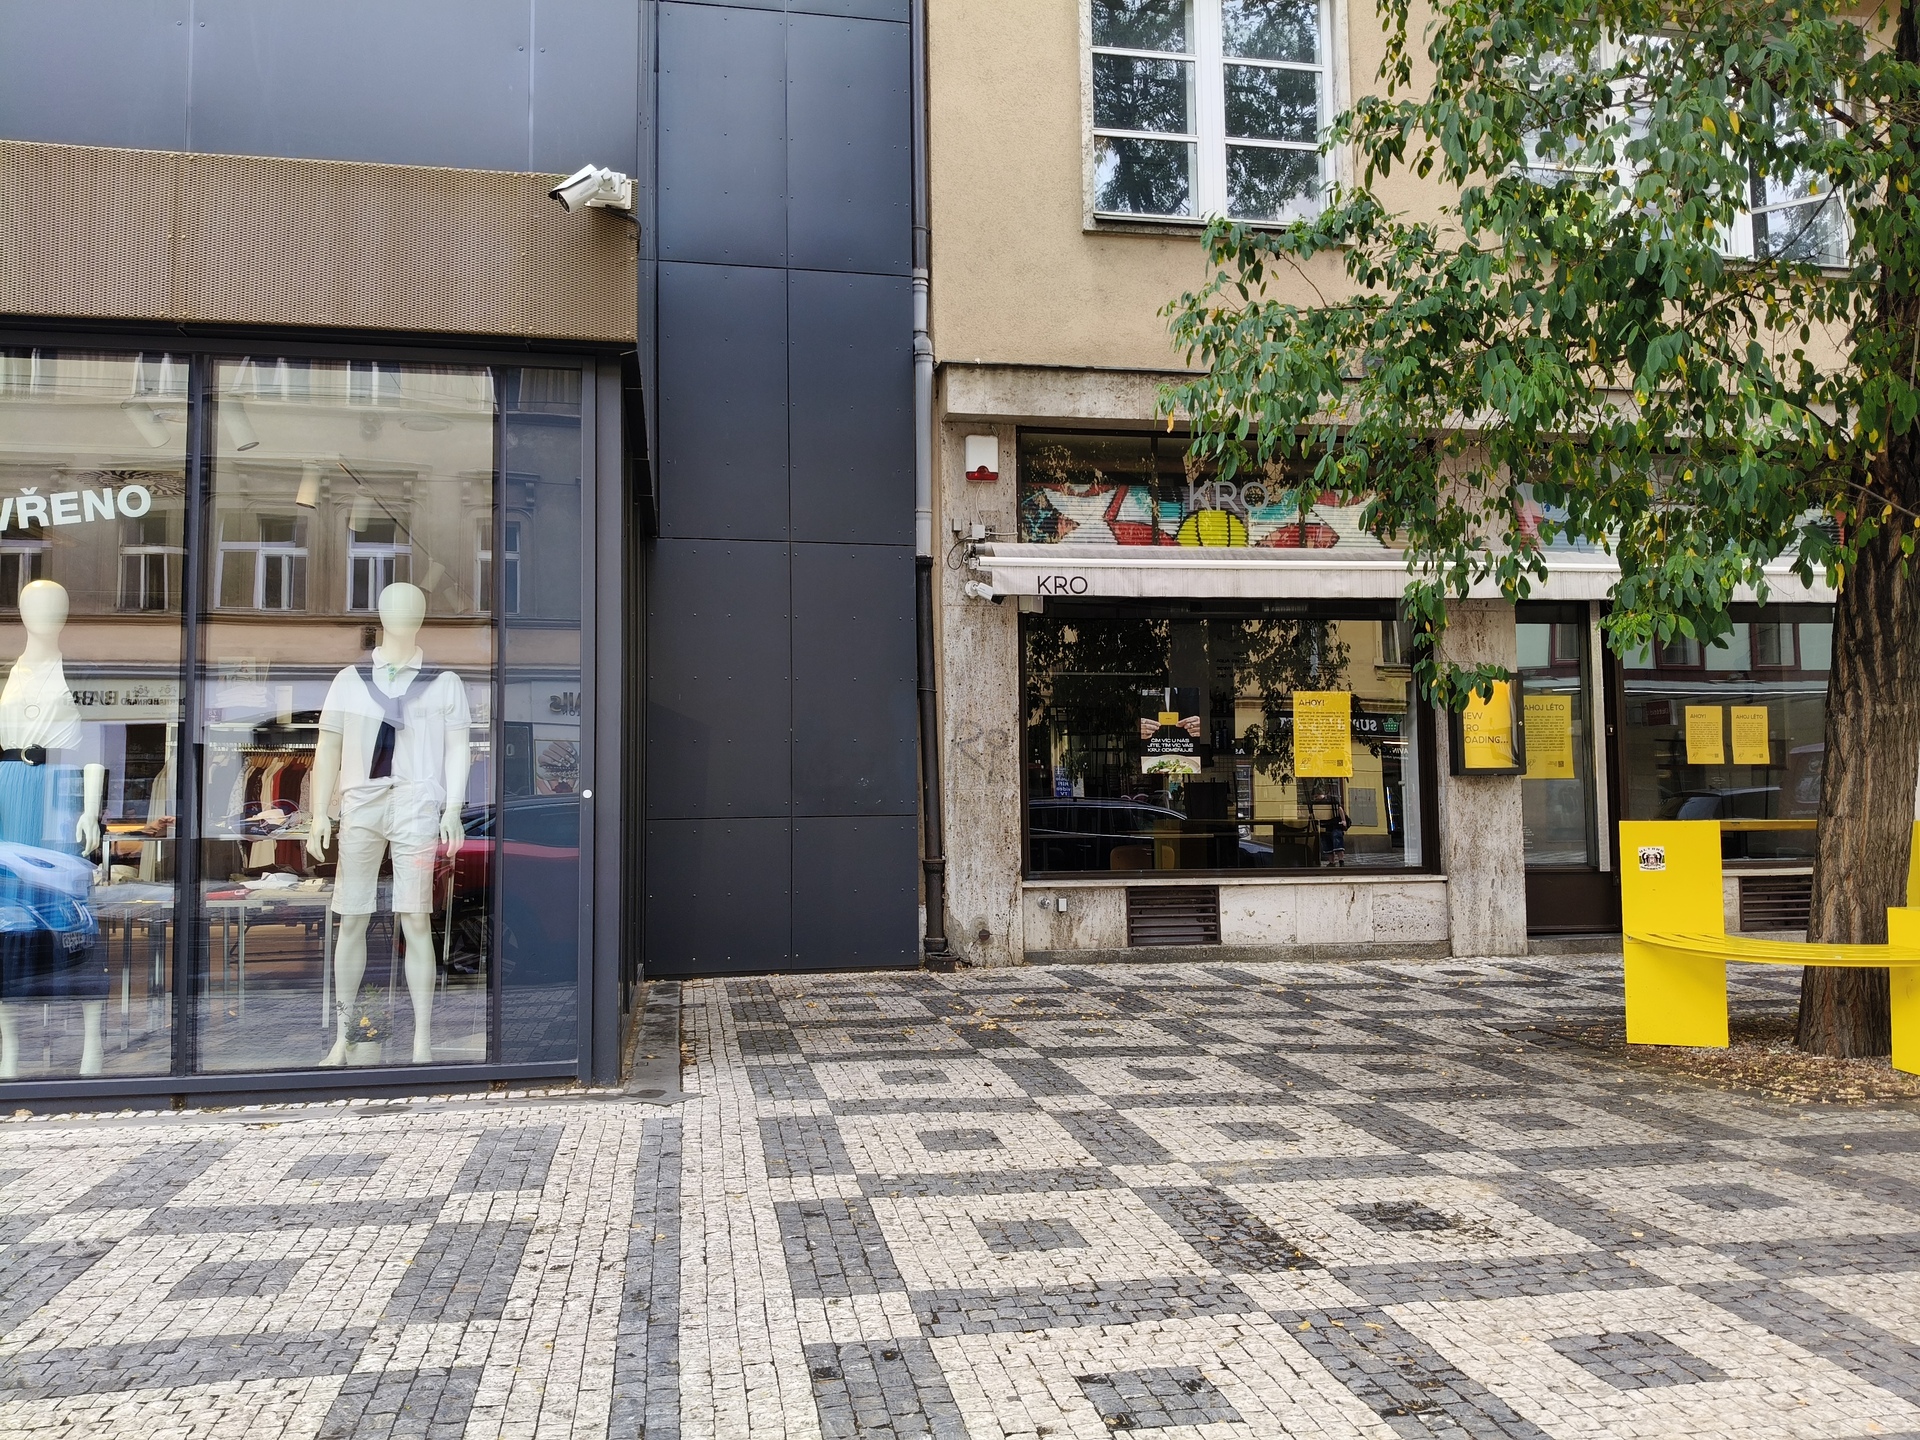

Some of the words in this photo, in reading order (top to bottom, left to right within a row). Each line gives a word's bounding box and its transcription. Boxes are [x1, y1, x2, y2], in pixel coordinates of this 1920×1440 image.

[1189, 482, 1269, 512] KRO
[1037, 576, 1088, 594] KRO
[1546, 701, 1564, 711] LÉTO
[1465, 736, 1509, 744] OADING...
